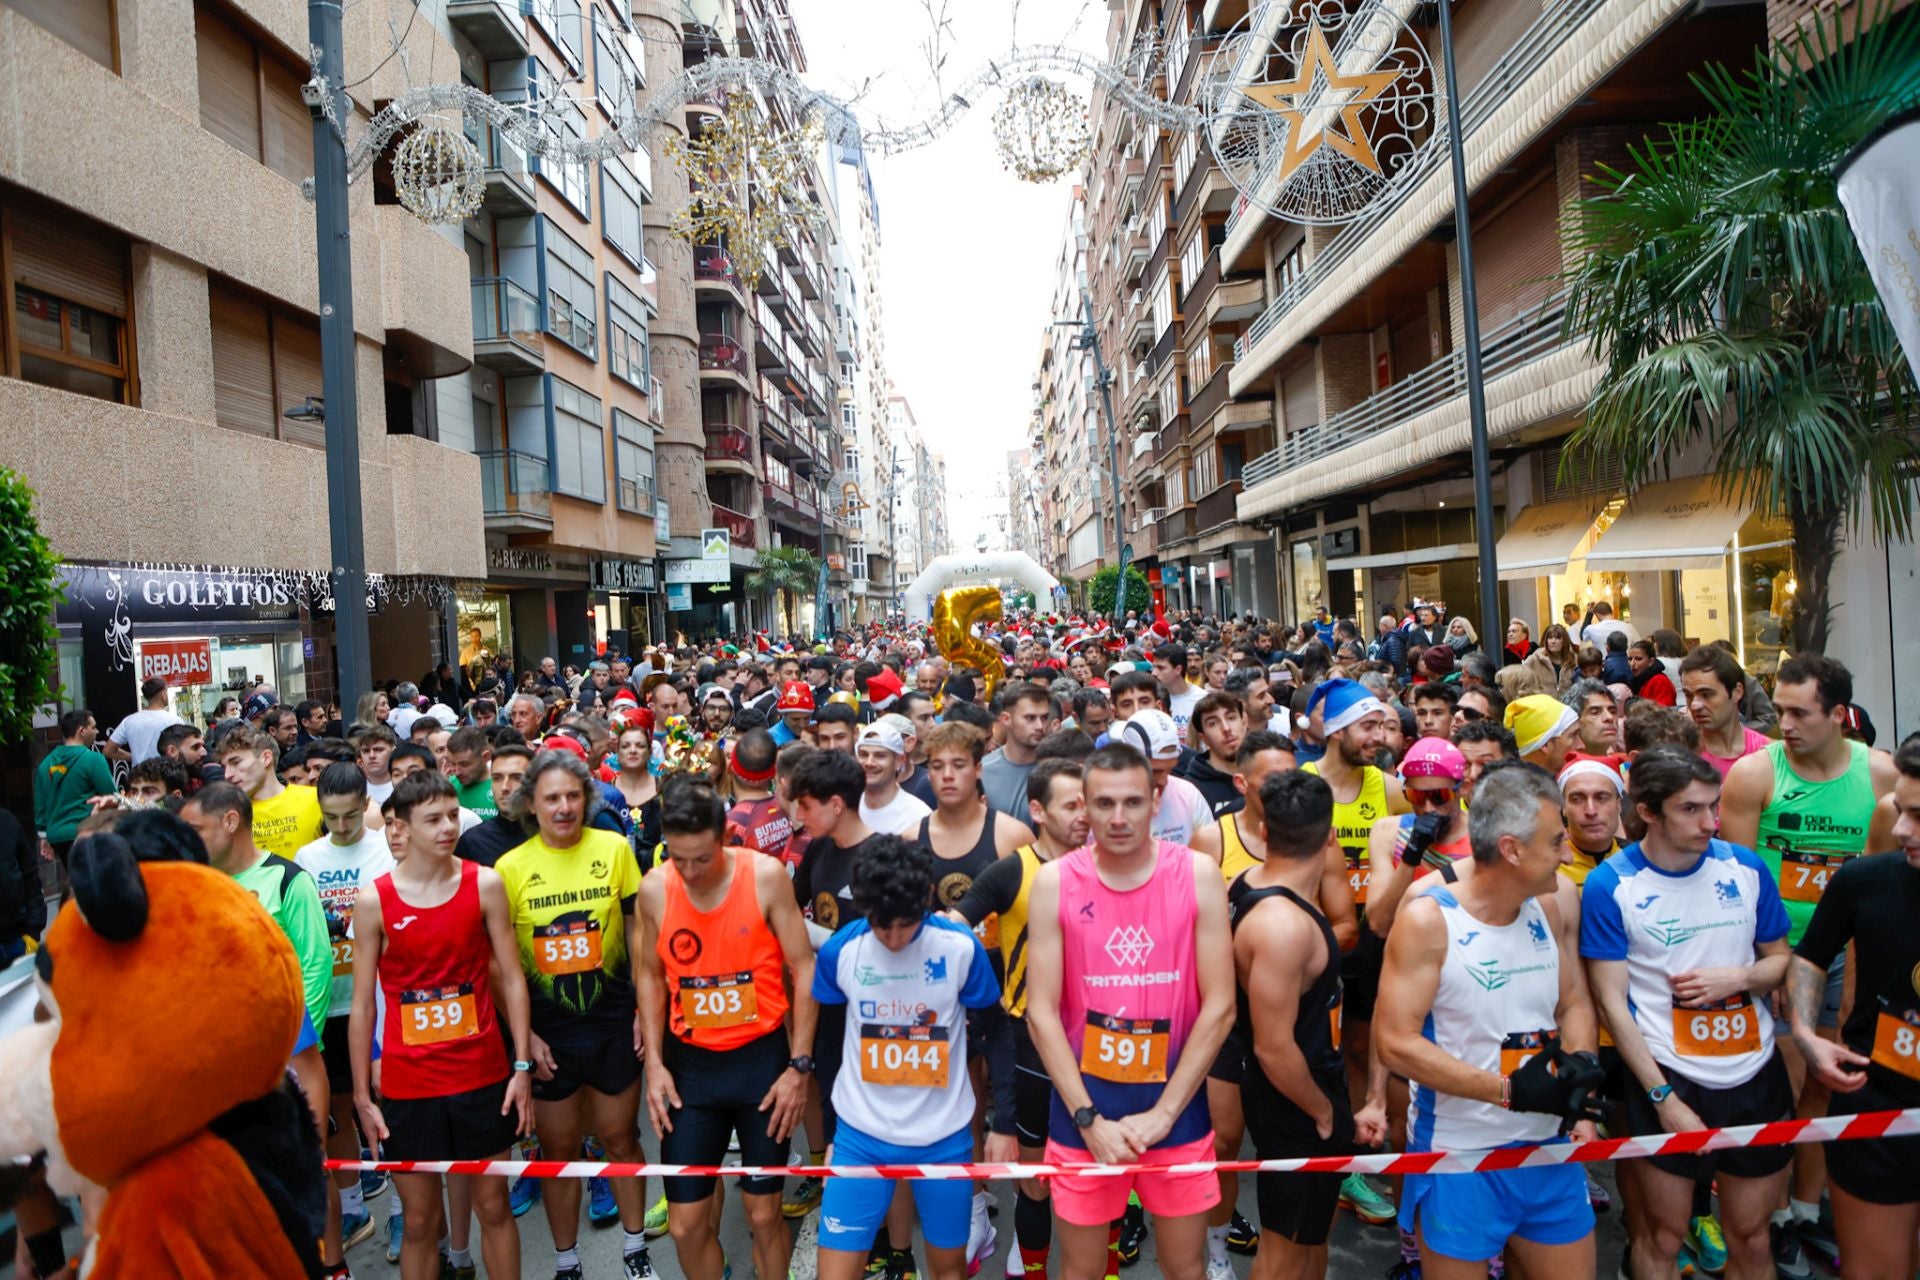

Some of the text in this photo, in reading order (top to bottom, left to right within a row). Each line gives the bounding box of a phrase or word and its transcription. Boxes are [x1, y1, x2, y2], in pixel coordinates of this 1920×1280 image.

[142, 579, 289, 606] GOLFITOS
[143, 651, 208, 677] REBAJAS
[755, 817, 788, 839] BUTANO
[1804, 814, 1833, 826] pan
[1807, 822, 1863, 836] moreno
[318, 867, 360, 885] SAN
[318, 881, 360, 890] SILVESTRE
[318, 886, 360, 899] LORCA
[528, 885, 612, 911] TRIATLÓN LORCA
[545, 936, 590, 962] 538
[1082, 970, 1180, 988] TRITANDEM
[693, 989, 742, 1016] 203
[414, 1001, 463, 1031] 539
[1690, 1013, 1747, 1042] 689
[868, 1042, 941, 1072] 1044
[1099, 1033, 1151, 1066] 591
